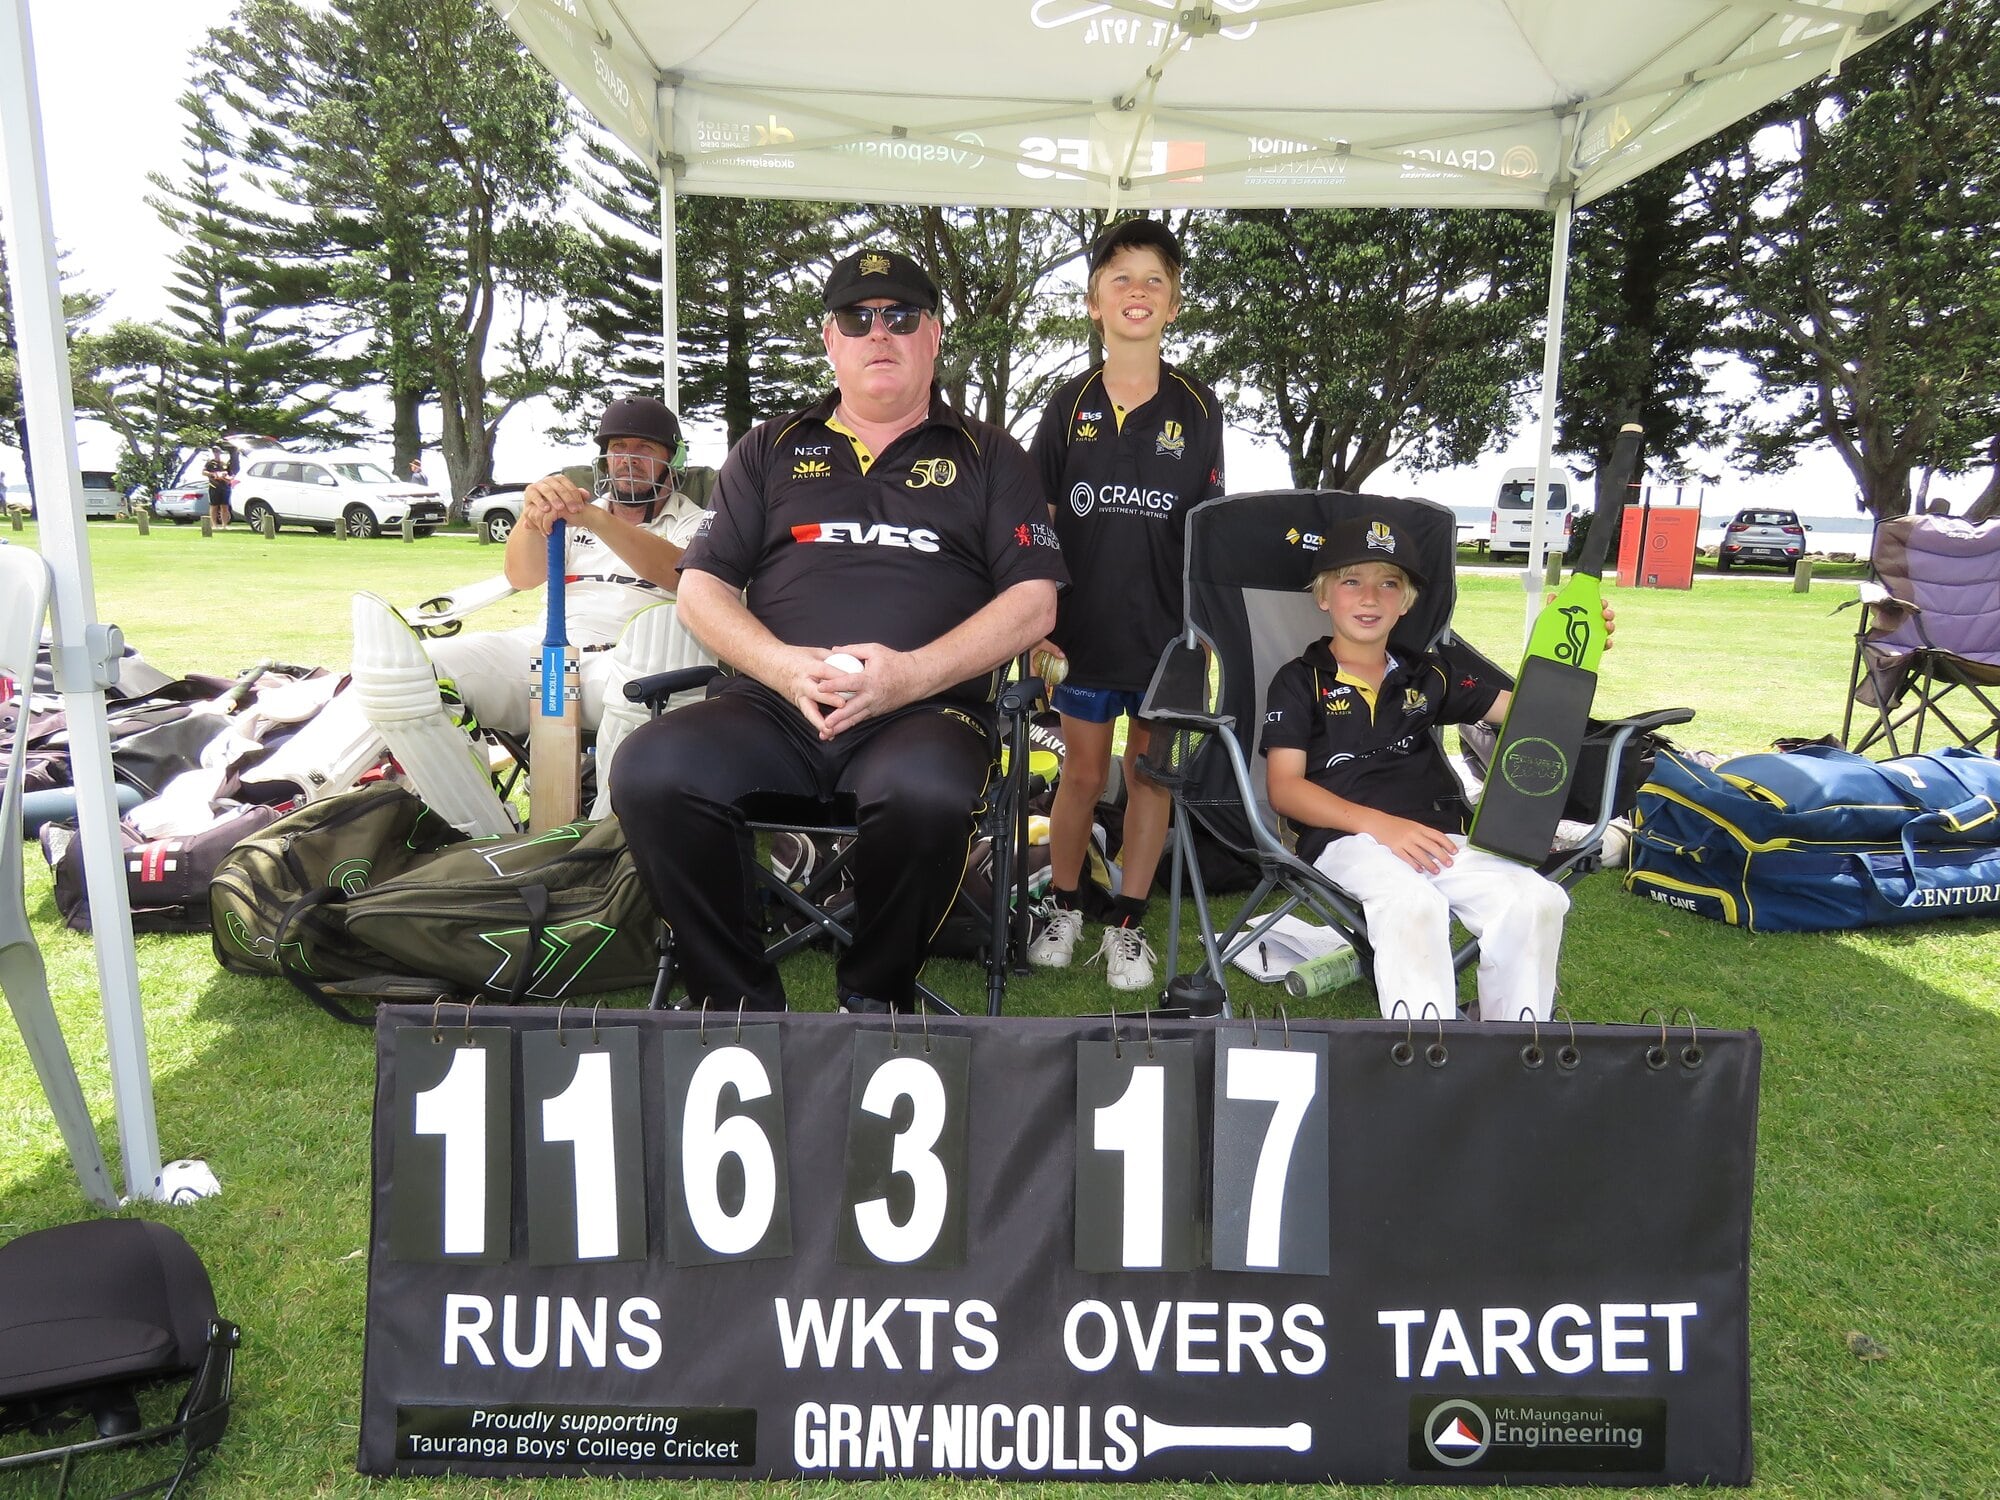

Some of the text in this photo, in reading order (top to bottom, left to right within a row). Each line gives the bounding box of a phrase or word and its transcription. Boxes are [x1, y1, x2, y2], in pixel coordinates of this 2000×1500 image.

[1081, 411, 1103, 421] EVES
[792, 472, 831, 480] PALADIN
[905, 457, 957, 489] 50
[1099, 484, 1174, 512] CRAIGS
[814, 522, 940, 553] EVES
[1031, 523, 1047, 536] THE
[1328, 686, 1352, 699] EVES
[1650, 889, 1697, 912] BAT CAVE
[853, 1056, 948, 1264] 3
[443, 1293, 1698, 1379] RUNS WKTS OVERS TARGET
[471, 1409, 678, 1436] Proudly supporting
[1494, 1422, 1643, 1449] Engineering
[409, 1434, 739, 1461] Tauranga Boys' College Cricket
[793, 1401, 1139, 1472] GRAY-NICOLLS
